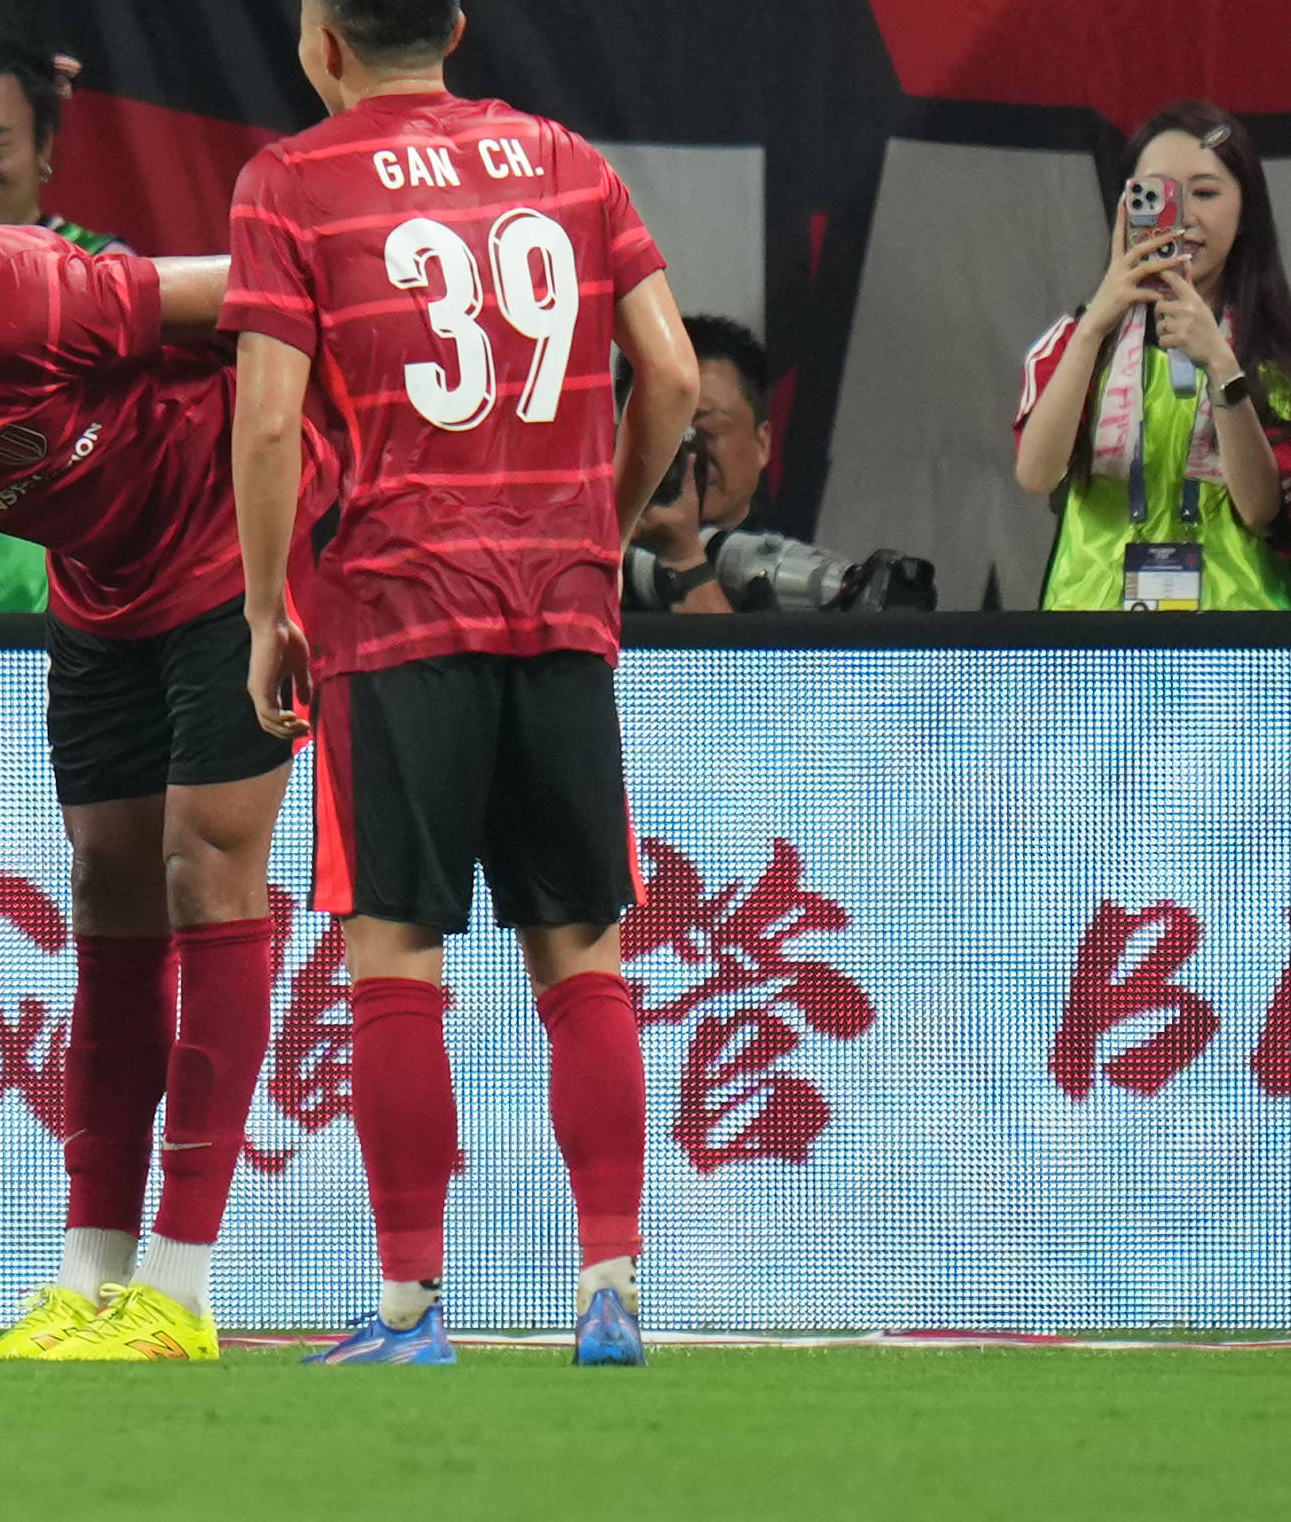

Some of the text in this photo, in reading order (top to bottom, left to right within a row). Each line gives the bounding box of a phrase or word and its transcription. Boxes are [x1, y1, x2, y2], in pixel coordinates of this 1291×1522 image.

[372, 137, 545, 189] GAN CH.
[383, 206, 580, 432] 39
